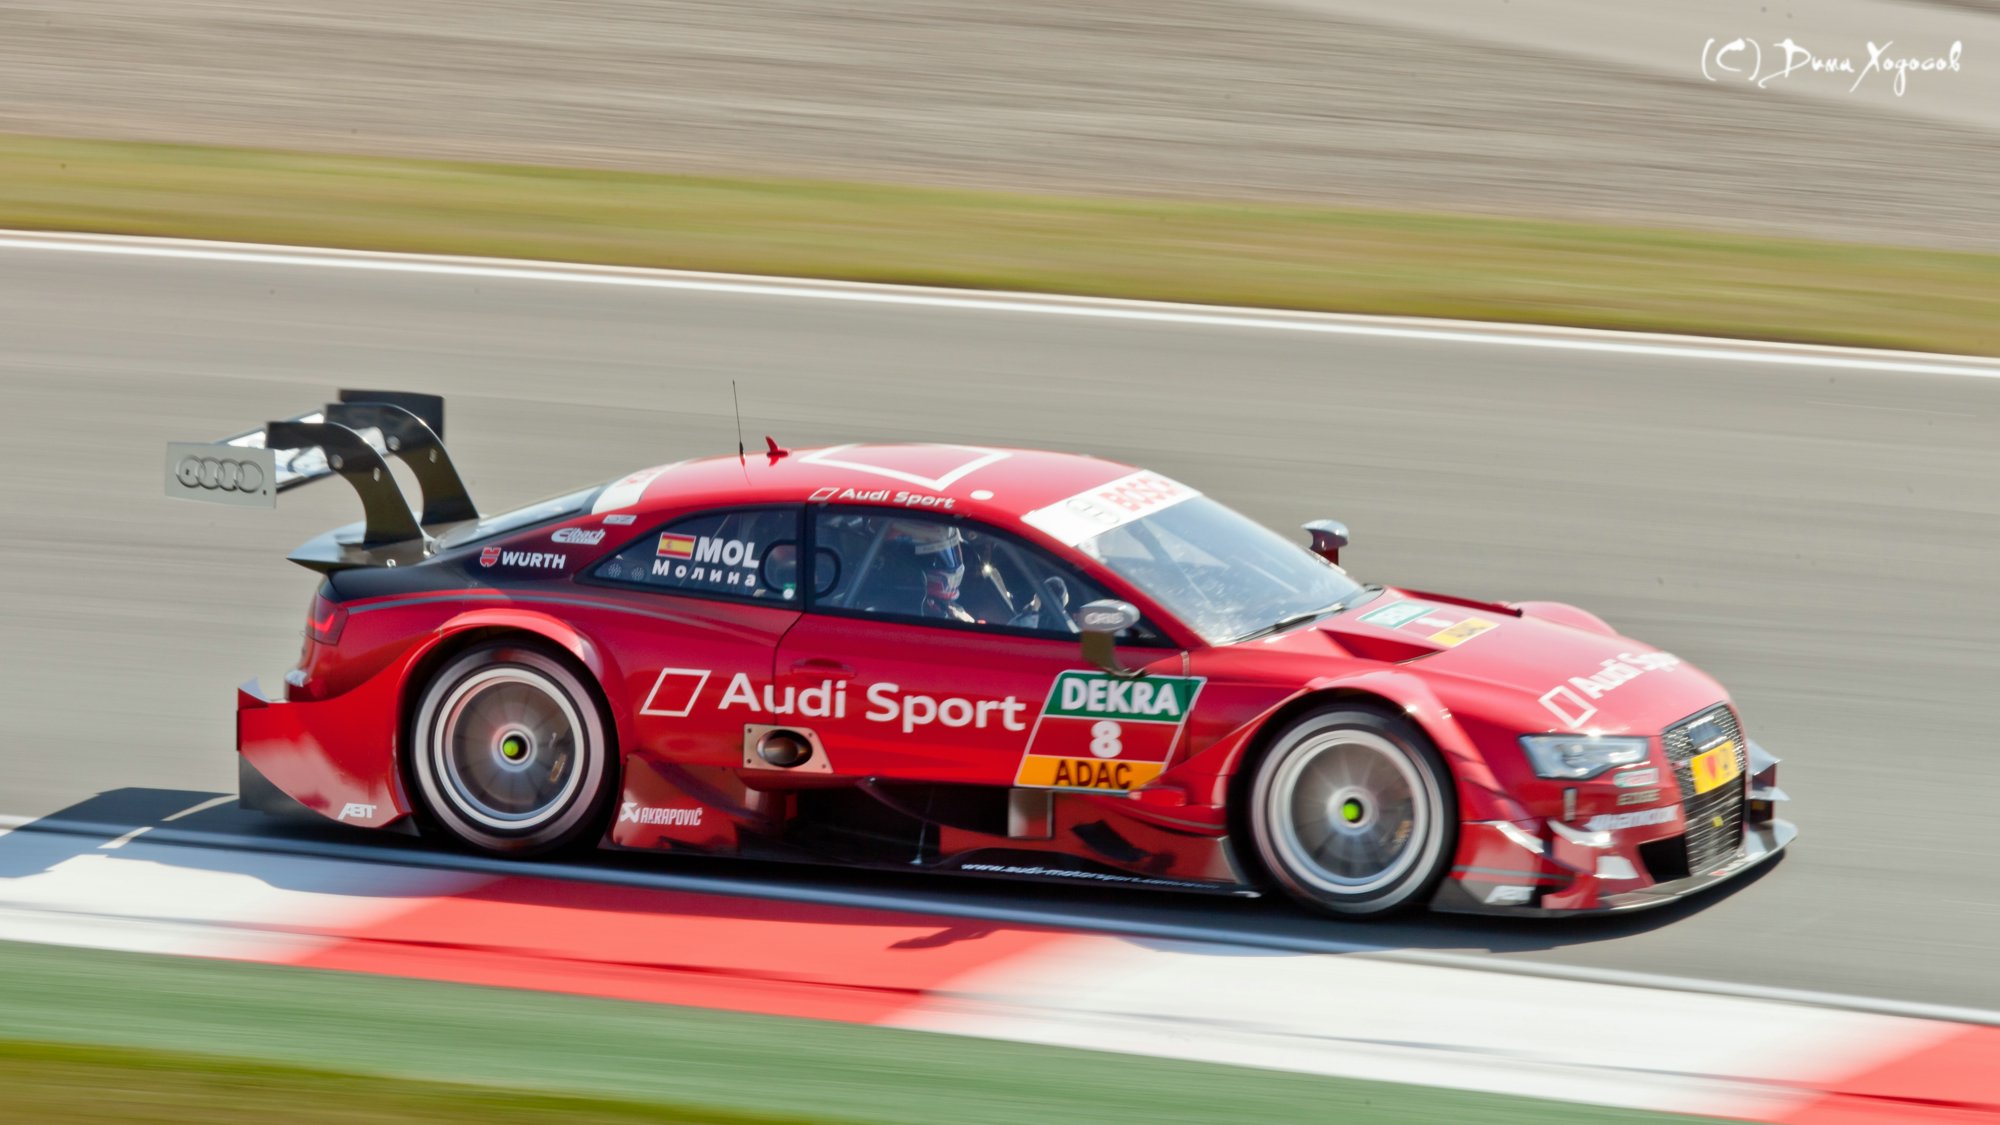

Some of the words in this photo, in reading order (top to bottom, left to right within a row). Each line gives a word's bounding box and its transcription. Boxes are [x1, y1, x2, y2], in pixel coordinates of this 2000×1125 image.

[838, 488, 891, 502] Audi
[893, 491, 956, 509] Sport
[695, 536, 760, 569] MOL
[652, 559, 757, 587] Молина
[718, 672, 847, 718] Audi
[865, 682, 1027, 733] Sport
[1060, 677, 1181, 716] DEKRA
[1089, 720, 1123, 759] 8
[1053, 759, 1133, 789] ADAC
[337, 802, 377, 821] ABT
